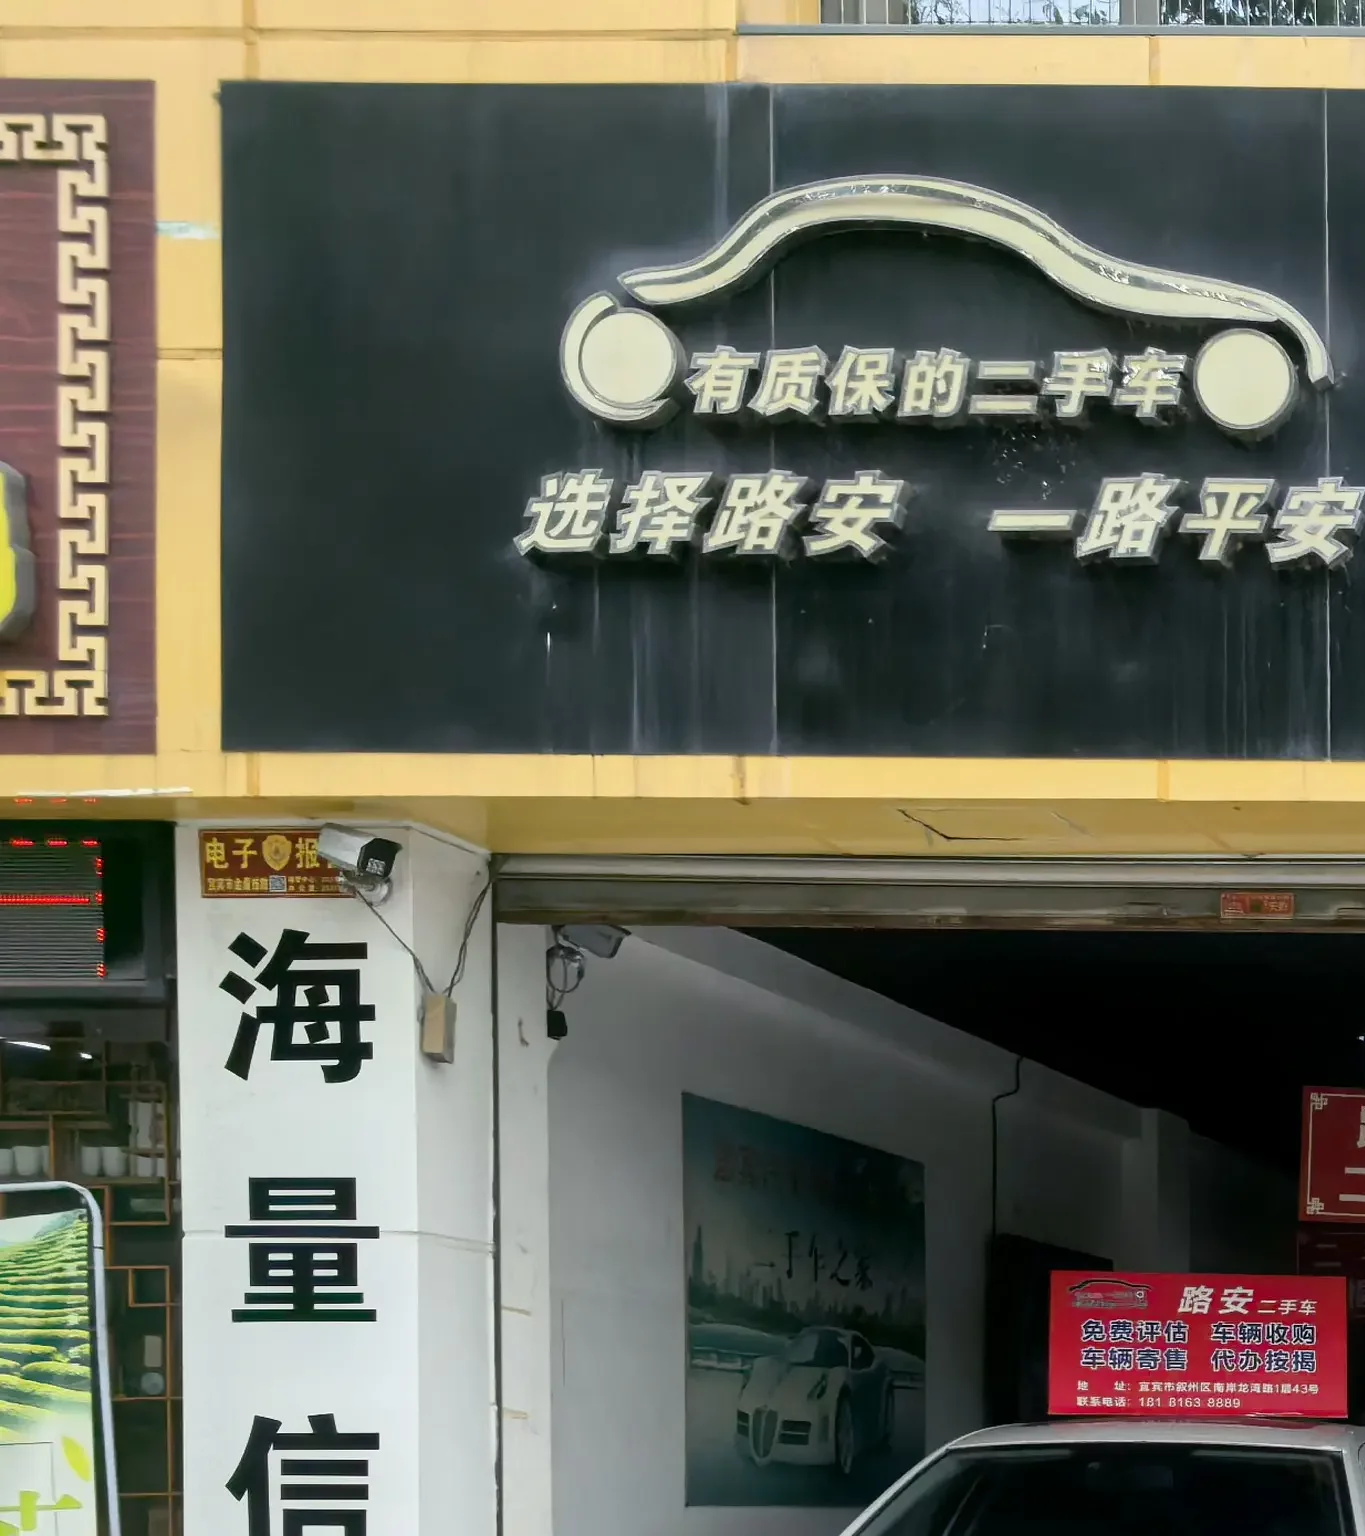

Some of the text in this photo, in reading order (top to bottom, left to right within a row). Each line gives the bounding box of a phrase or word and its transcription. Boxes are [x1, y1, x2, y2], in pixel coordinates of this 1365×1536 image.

[686, 345, 1189, 421] 有质保的二手车
[514, 468, 915, 566] 选择路安
[205, 837, 258, 869] 电子
[1081, 1319, 1317, 1345] 免费评估 车辆收购
[1080, 1347, 1317, 1373] 车辆寄售 代办按揭
